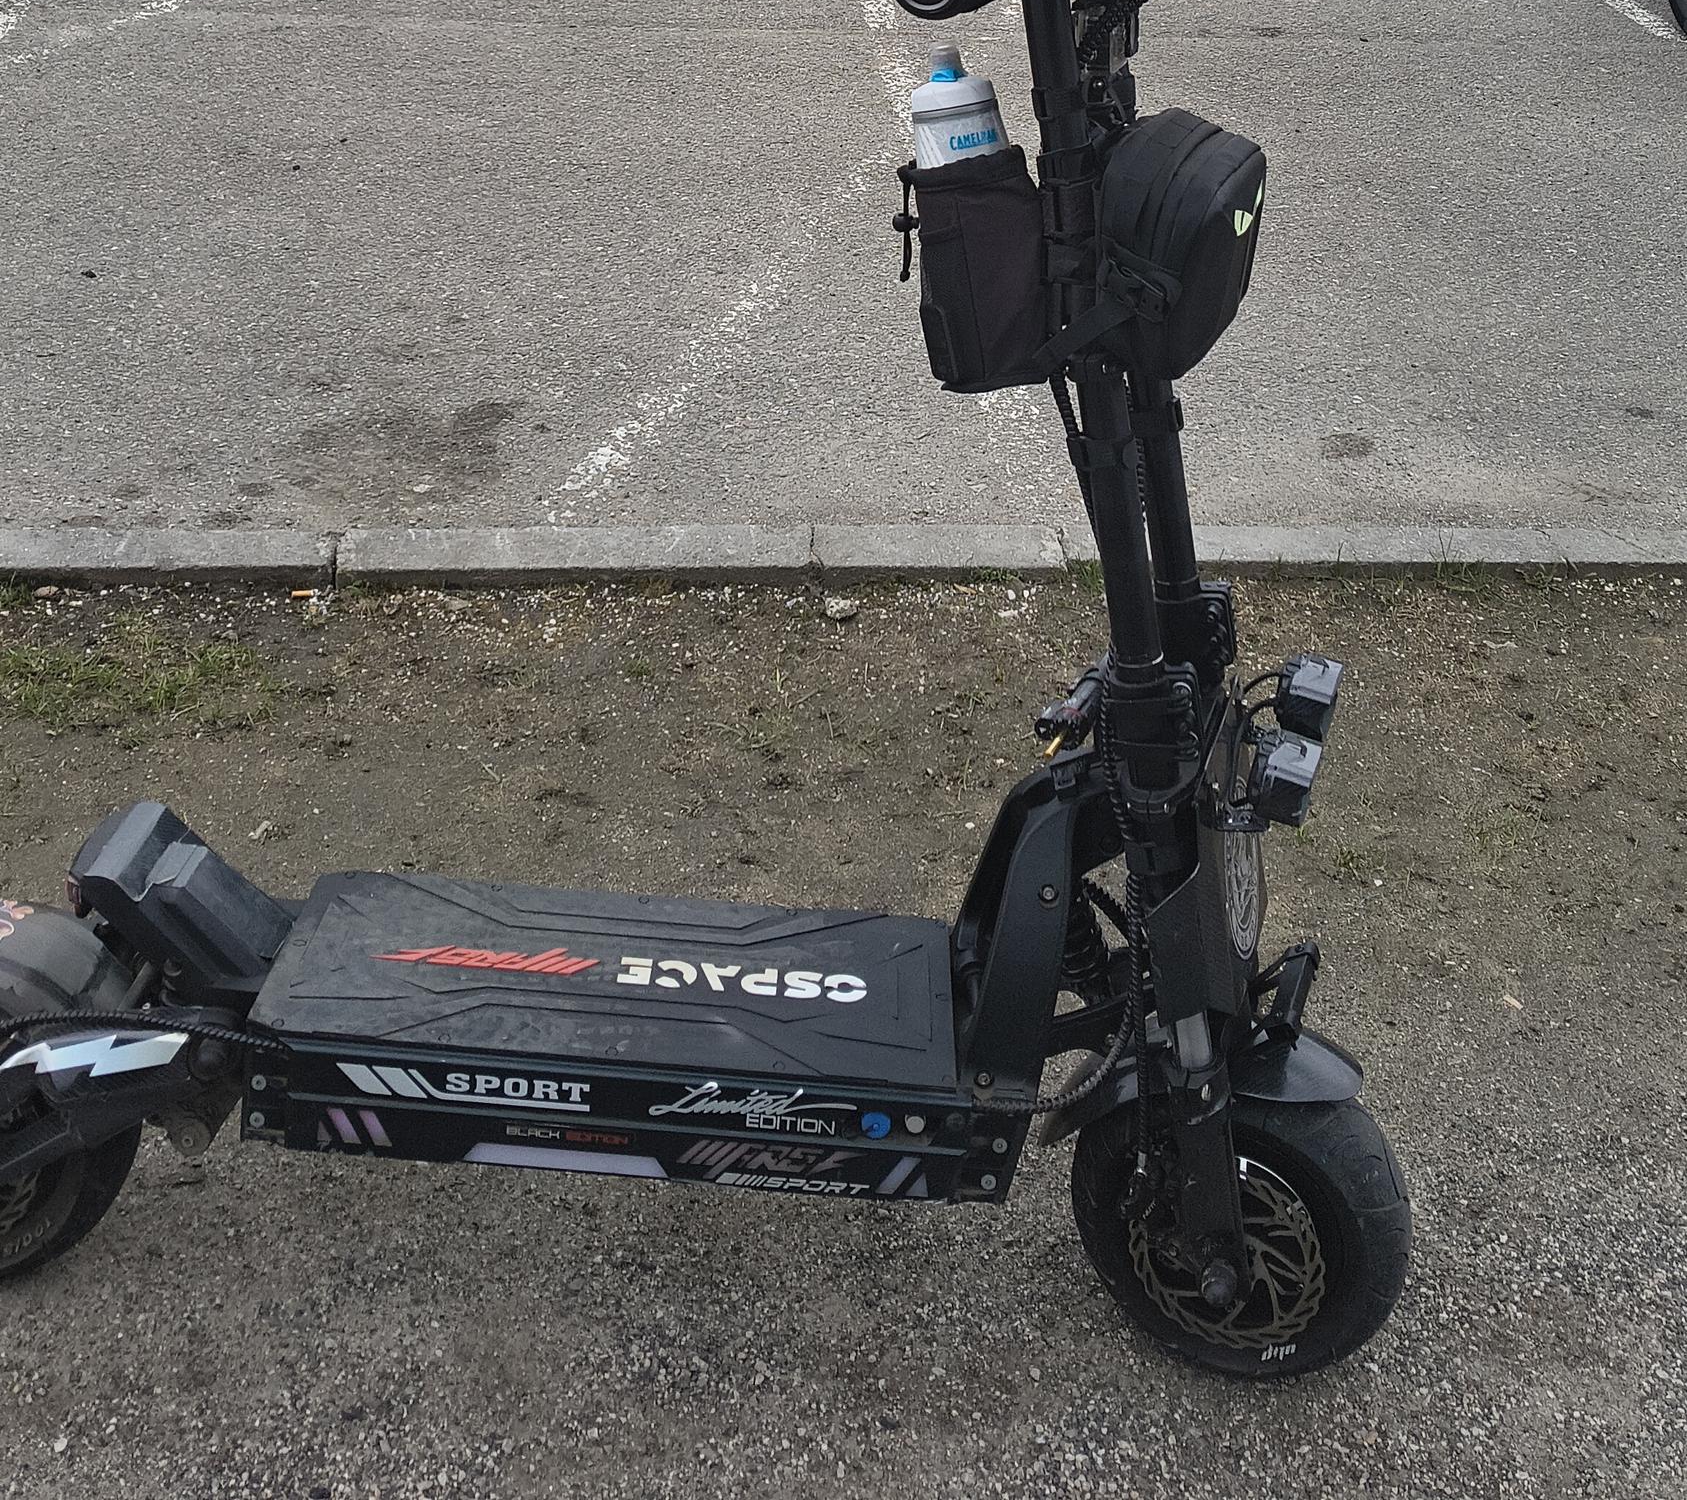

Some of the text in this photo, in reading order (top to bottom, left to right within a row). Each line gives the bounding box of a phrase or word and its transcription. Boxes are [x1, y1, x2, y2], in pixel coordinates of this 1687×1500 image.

[445, 1072, 590, 1102] SPORT
[649, 1081, 857, 1116] Limited
[506, 1124, 560, 1140] BLACK
[745, 1114, 835, 1136] EDITION
[762, 1175, 870, 1195] SPORT
